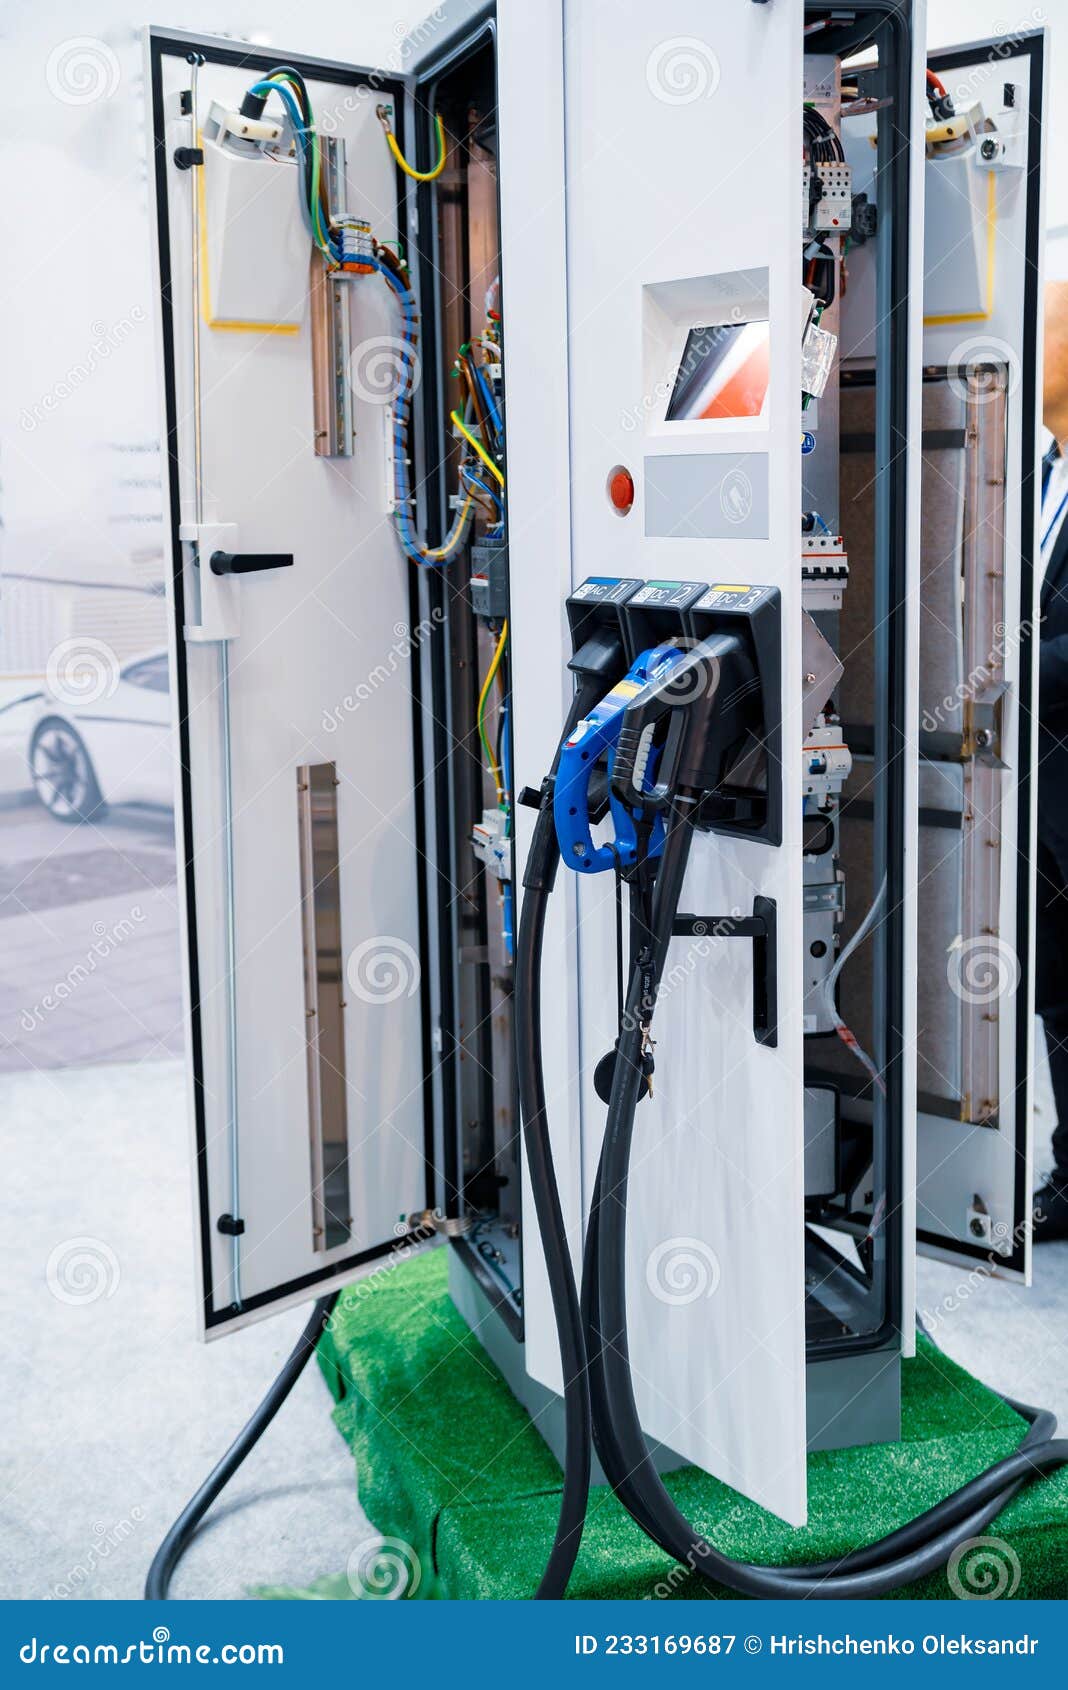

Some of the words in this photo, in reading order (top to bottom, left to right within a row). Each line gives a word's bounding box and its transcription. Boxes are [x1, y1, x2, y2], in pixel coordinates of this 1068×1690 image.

[591, 585, 608, 595] AC
[610, 583, 628, 599] 1
[649, 589, 670, 599] DC
[669, 586, 692, 603] 2
[716, 593, 738, 604] DC
[739, 590, 761, 607] 3
